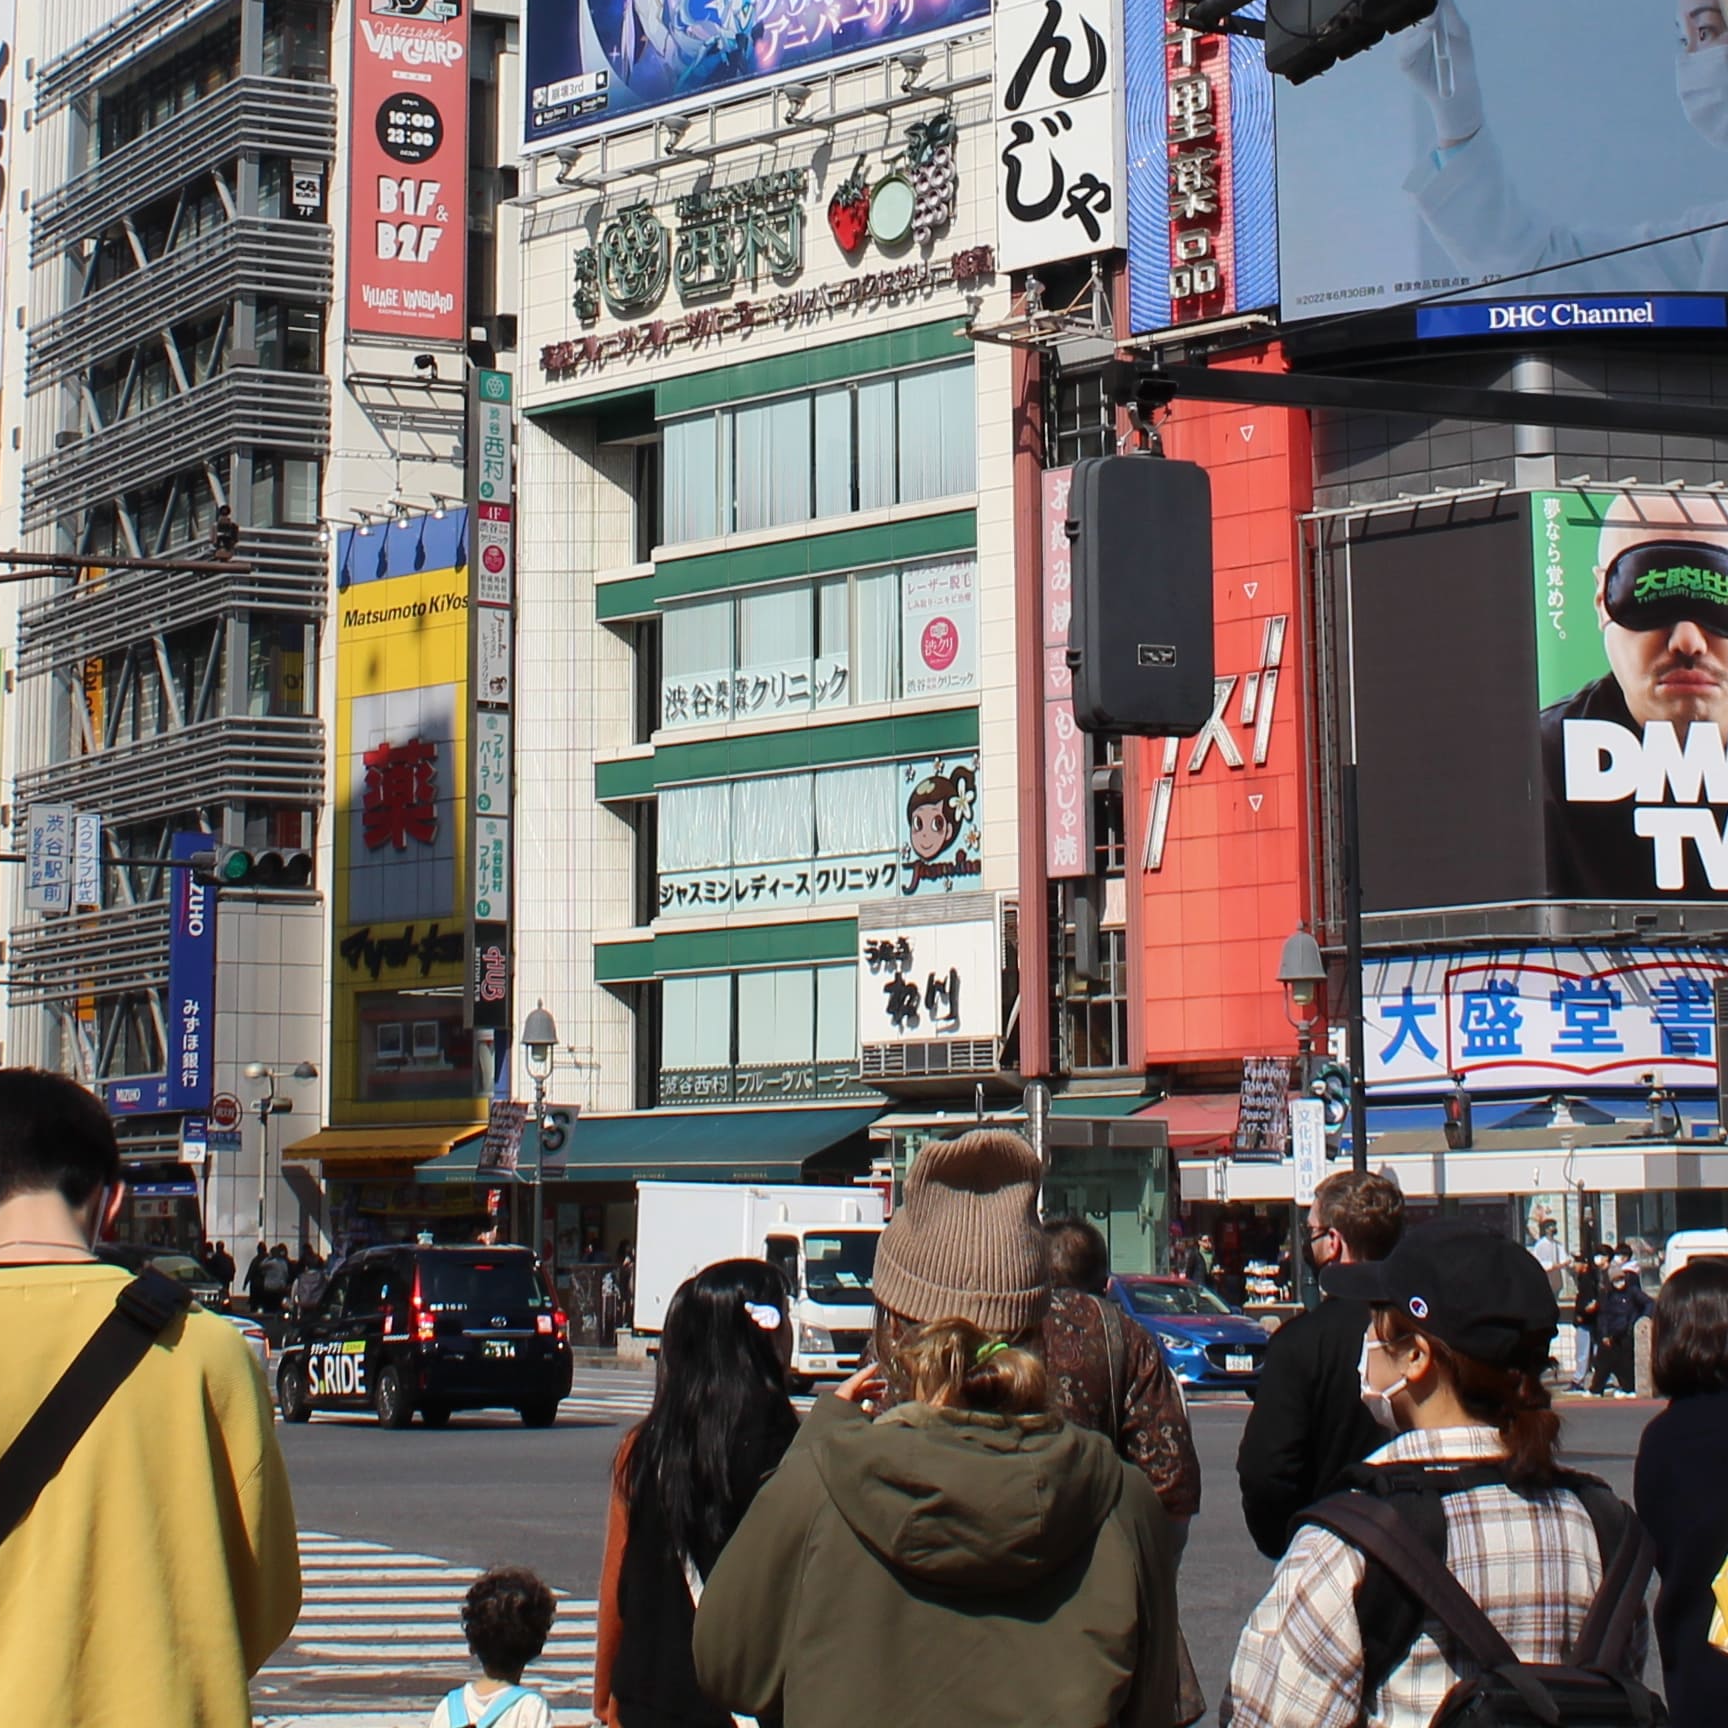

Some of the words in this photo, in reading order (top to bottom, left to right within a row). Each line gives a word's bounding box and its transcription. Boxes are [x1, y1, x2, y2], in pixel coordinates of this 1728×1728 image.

[360, 19, 464, 67] VANGUARD
[298, 206, 314, 218] 7F
[378, 174, 442, 217] B1F
[376, 220, 443, 263] B2F
[361, 283, 400, 310] VILLAGE
[402, 286, 454, 315] VANGUARD
[1488, 306, 1545, 330] DHC
[1550, 301, 1654, 328] Channel
[486, 506, 502, 519] 4F
[1541, 497, 1567, 642] 夢なら覚めて。
[342, 597, 428, 631] Matsumoto
[429, 591, 469, 616] KiYos
[362, 742, 439, 852] 薬
[43, 813, 65, 904] 渋谷駅前
[77, 819, 96, 903] スクランブル式
[181, 999, 201, 1088] みずほ銀行
[663, 1073, 728, 1098] 渋谷西村
[1298, 1109, 1314, 1189] 文化村通り
[307, 1355, 367, 1395] S.RIDE
